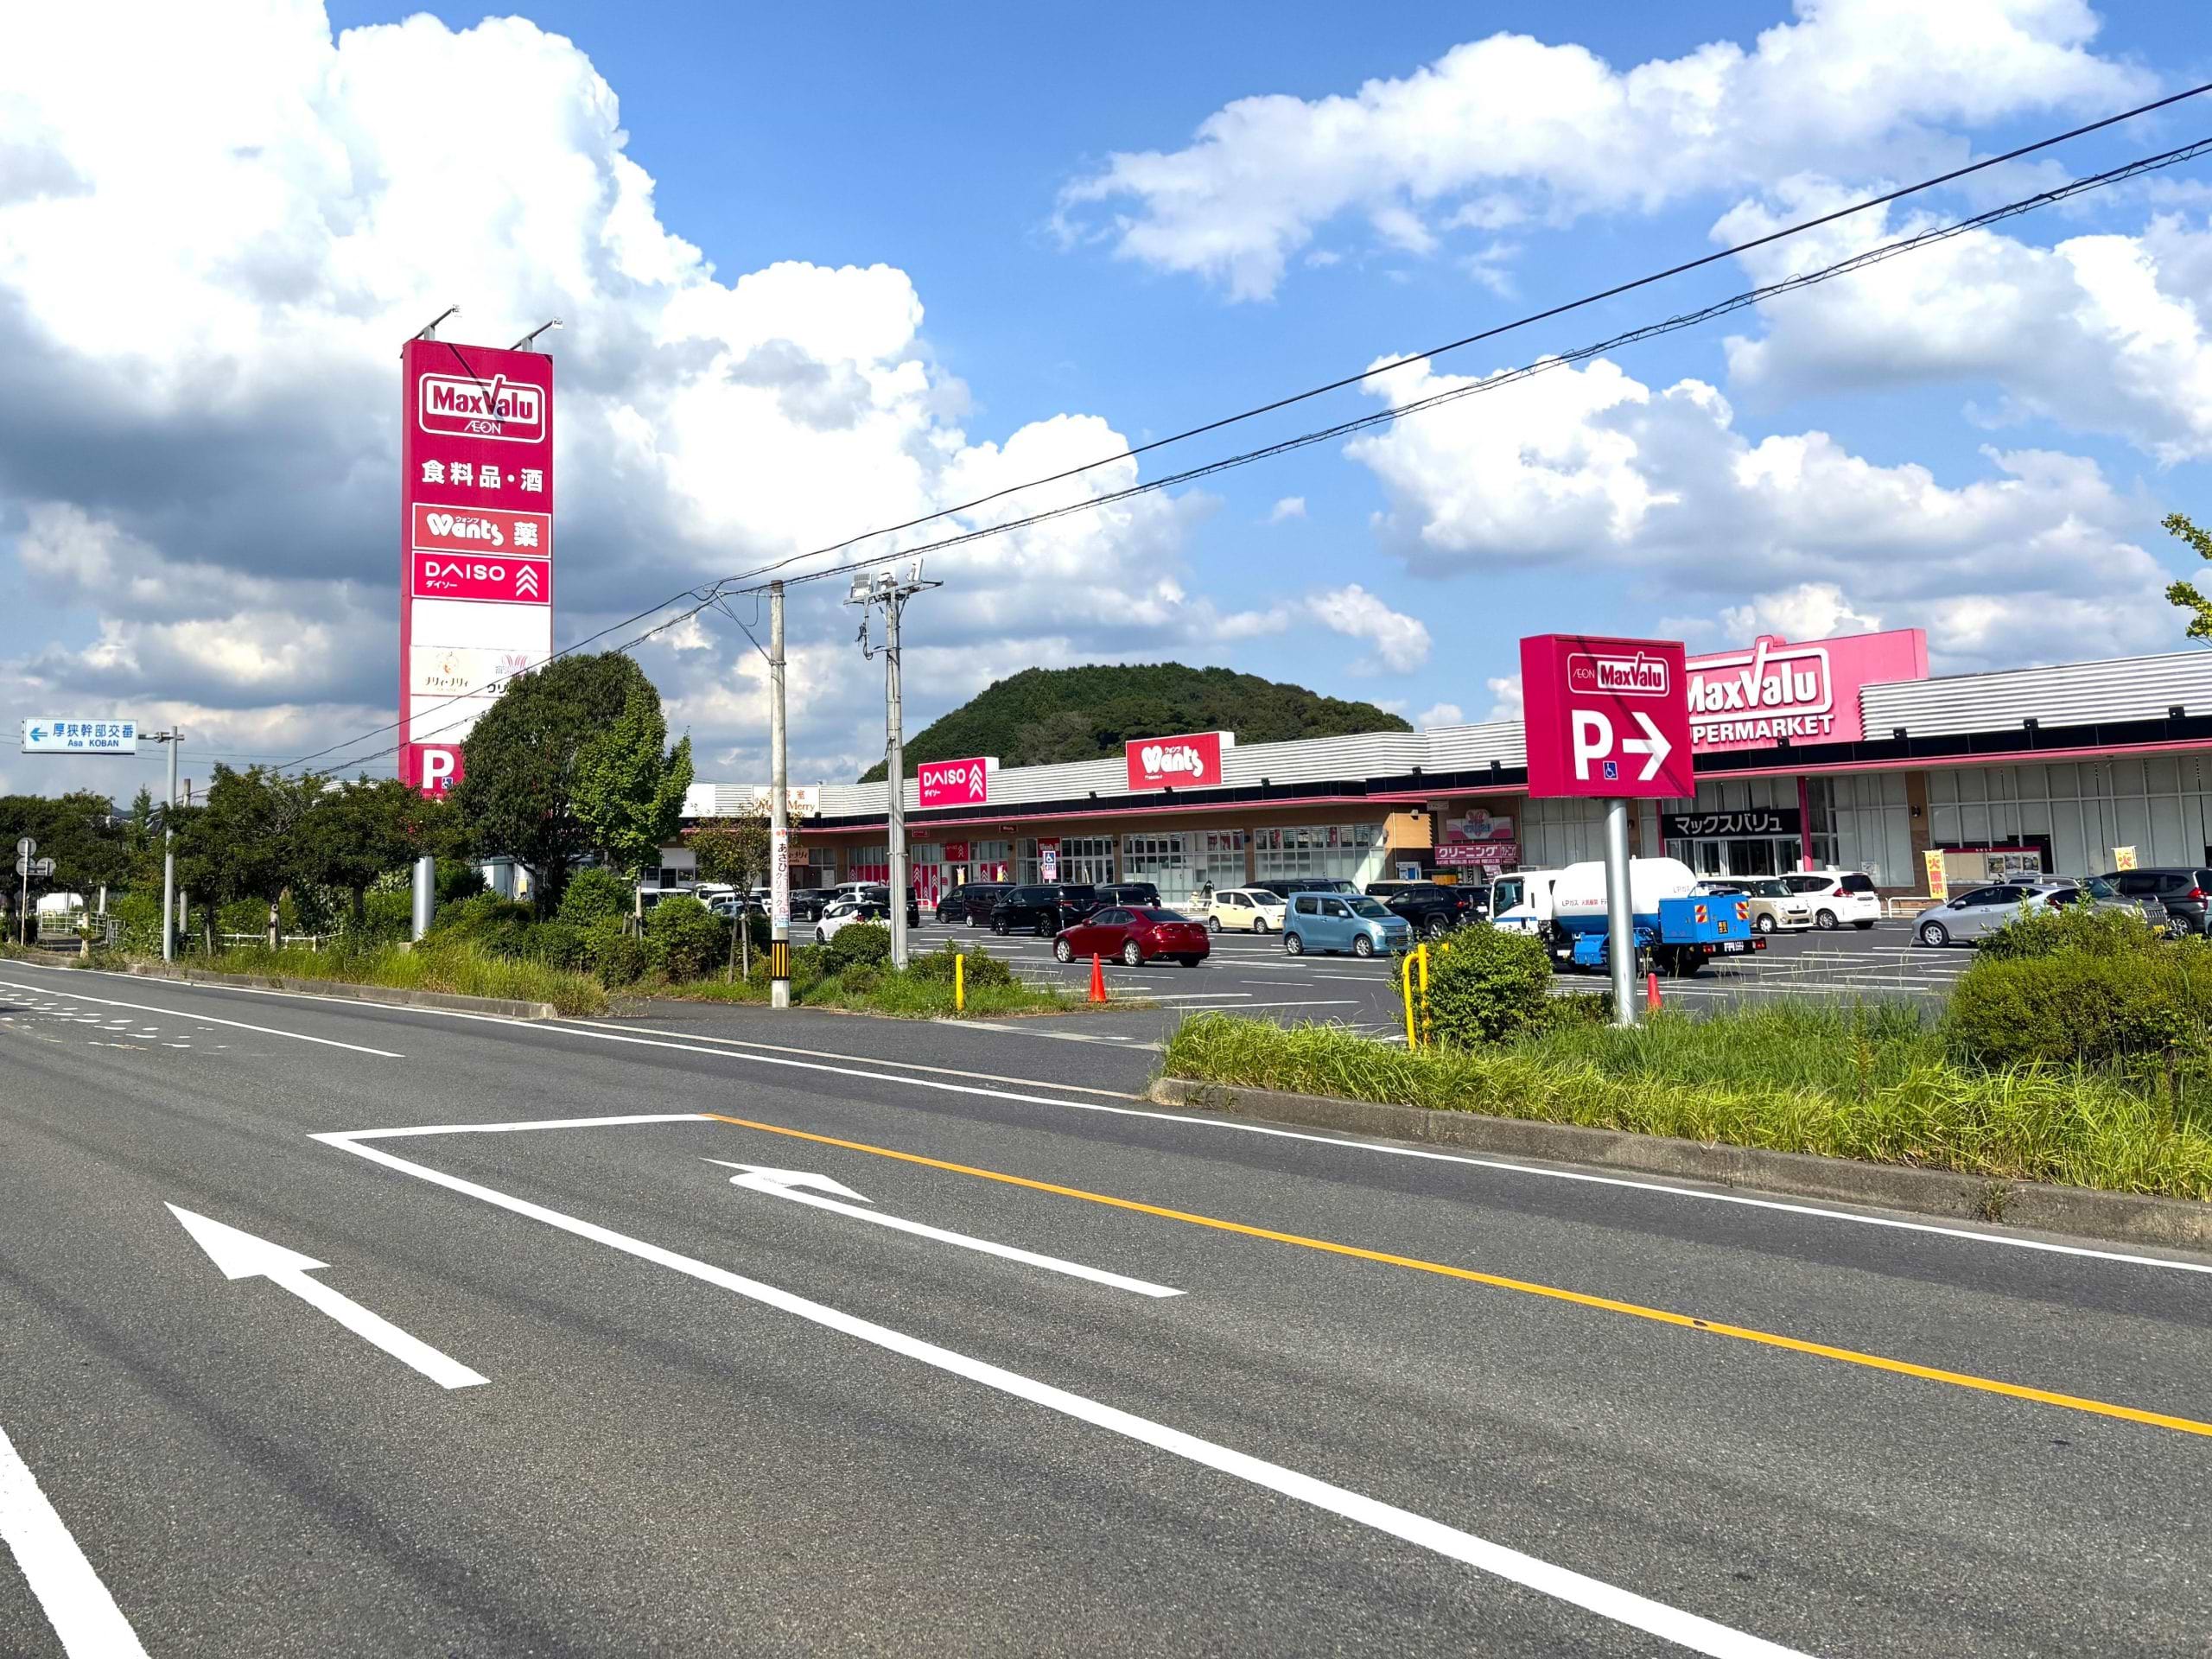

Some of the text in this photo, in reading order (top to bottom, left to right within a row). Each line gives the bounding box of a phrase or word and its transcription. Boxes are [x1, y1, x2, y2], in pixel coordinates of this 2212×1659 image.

[433, 378, 533, 419] MaxValu
[422, 460, 543, 493] 食料品・酒
[426, 512, 538, 548] Wants 薬
[424, 561, 505, 582] DAISO
[425, 580, 458, 588] ダイソー
[1600, 653, 1662, 687] MaxValu
[53, 723, 133, 738] 厚狭幹部交番
[67, 739, 83, 747] Asa
[1691, 715, 1834, 744] PERMARKET
[1572, 709, 1613, 780] P
[423, 749, 454, 789] P
[1141, 745, 1204, 778] Wants
[924, 768, 966, 786] DAISO
[1675, 813, 1783, 835] マックスバリュ
[1439, 846, 1498, 858] クリーニング
